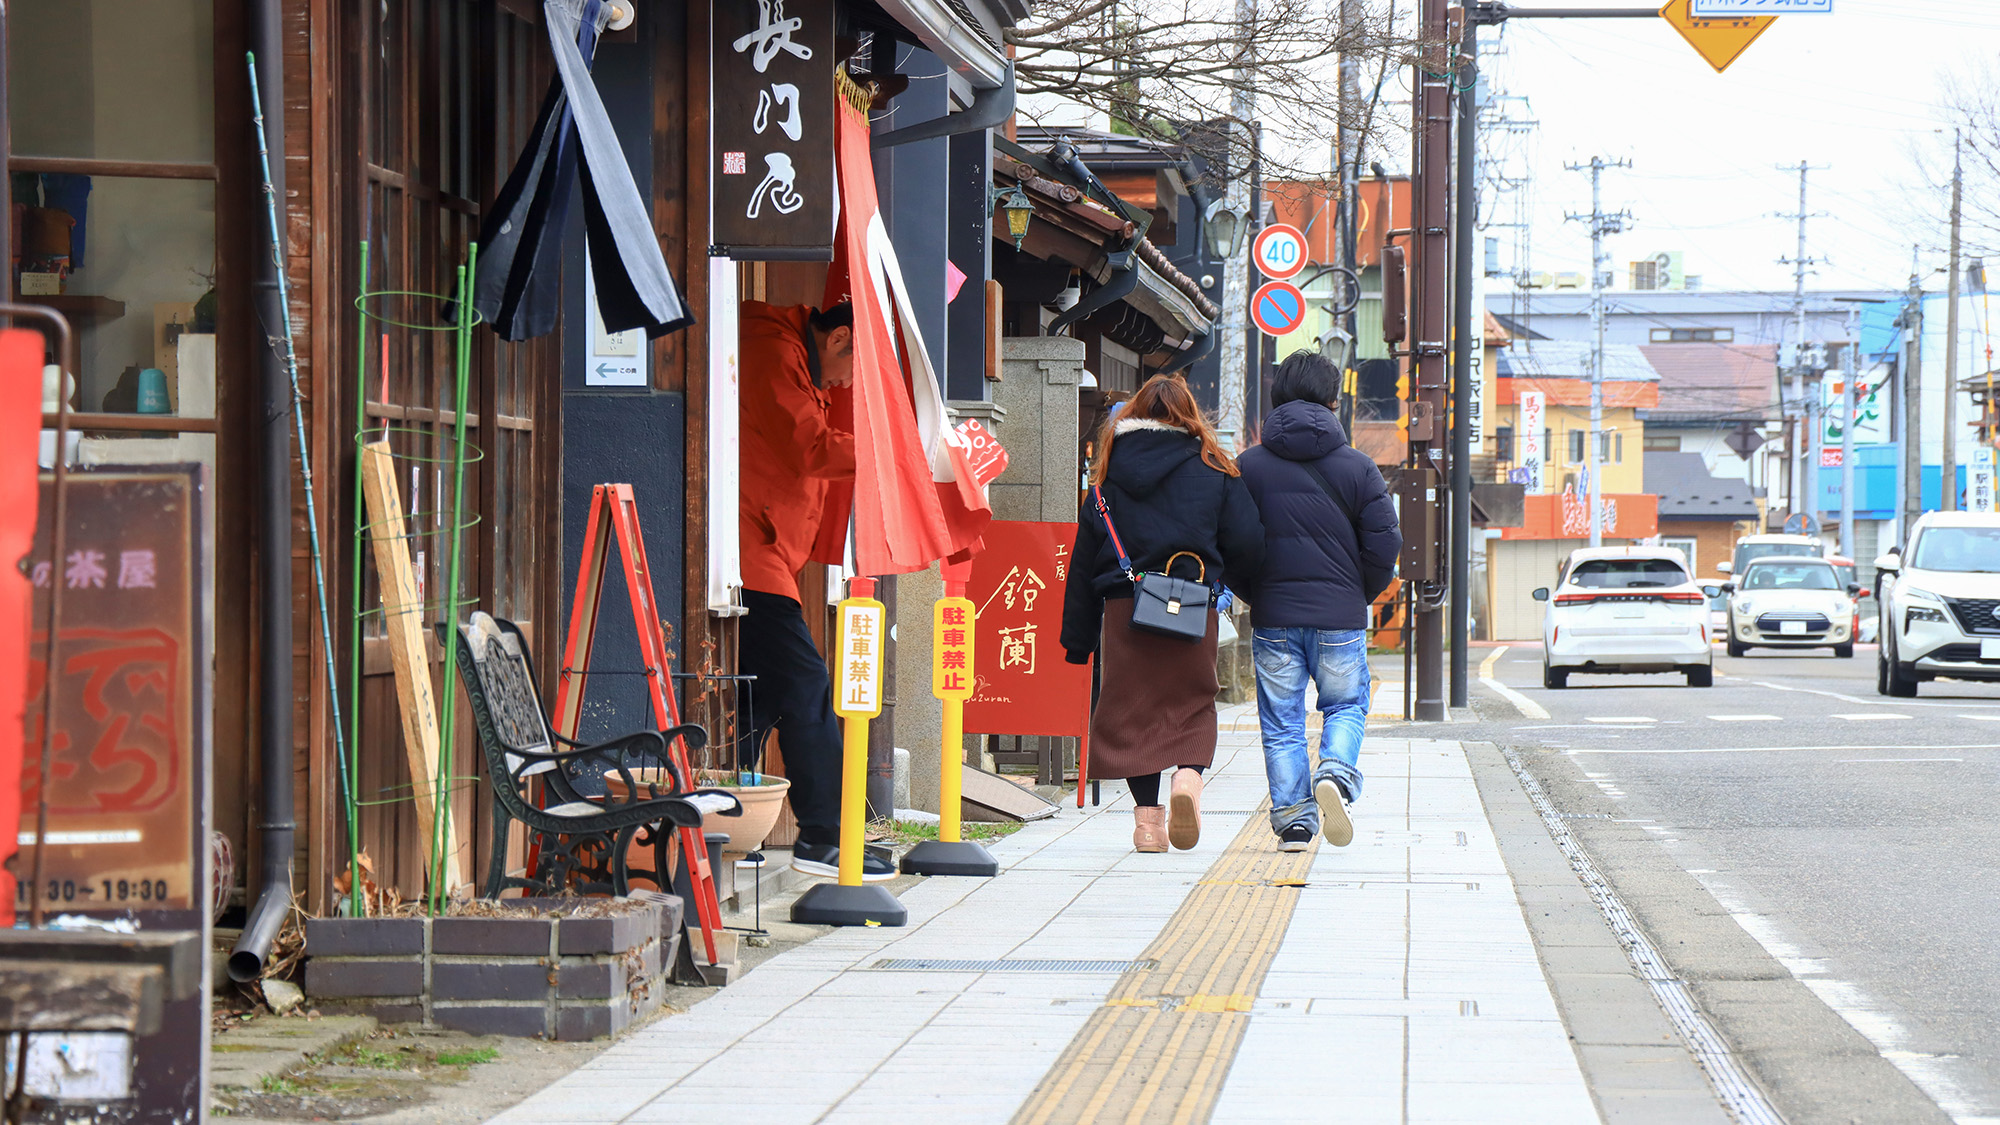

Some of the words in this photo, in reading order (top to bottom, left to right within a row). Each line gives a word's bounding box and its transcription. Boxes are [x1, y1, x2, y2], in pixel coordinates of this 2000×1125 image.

[1266, 240, 1295, 264] 40
[1055, 543, 1068, 582] 工房
[847, 614, 873, 705] 駐車禁止
[941, 606, 966, 691] 駐車禁止
[974, 565, 1046, 675] 鈴蘭
